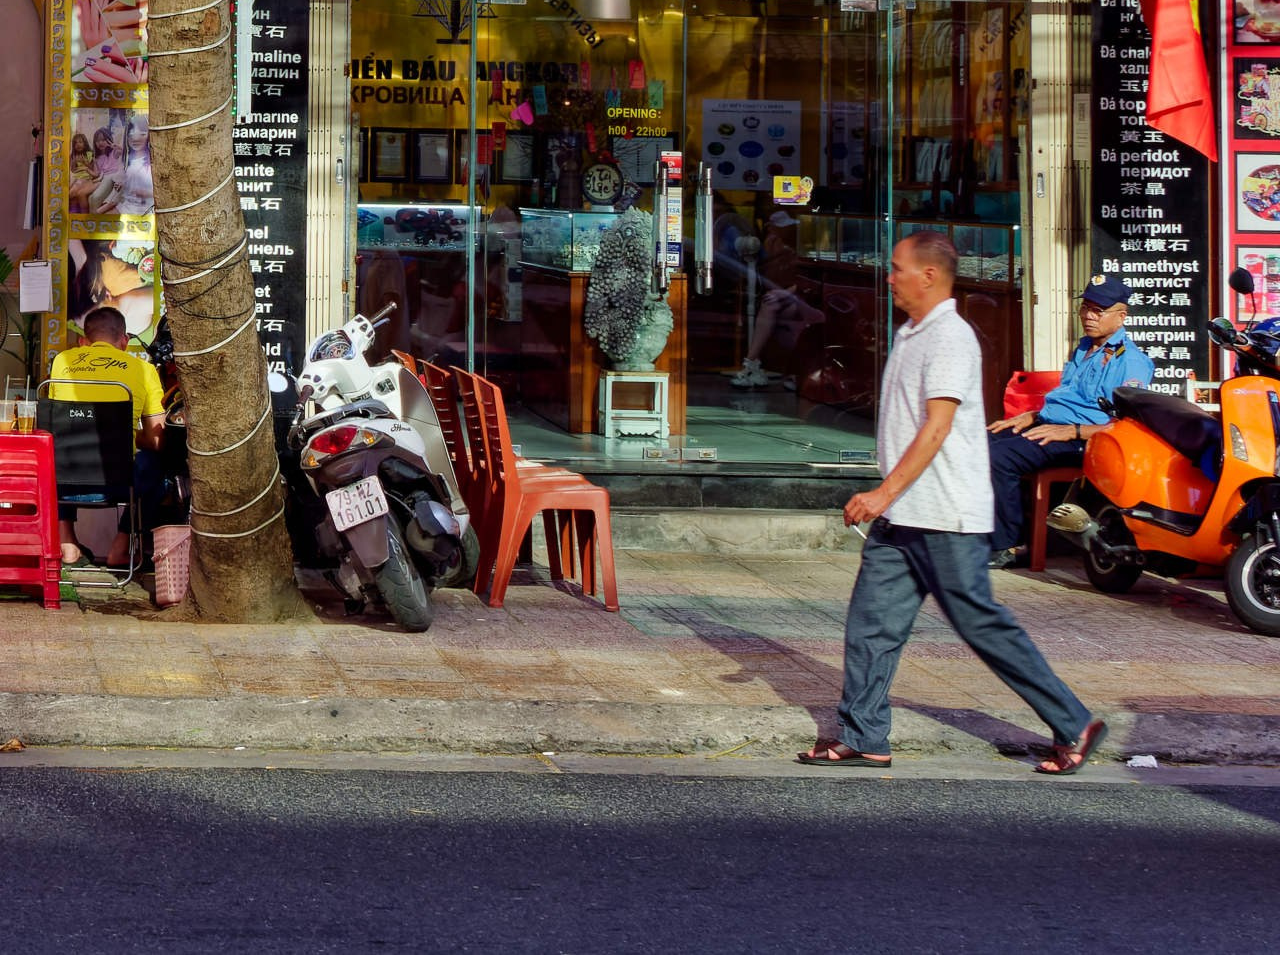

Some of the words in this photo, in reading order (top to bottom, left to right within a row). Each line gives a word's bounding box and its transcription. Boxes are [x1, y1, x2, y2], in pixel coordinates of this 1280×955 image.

[1101, 45, 1117, 59] Đá
[351, 51, 393, 81] IỂN
[402, 54, 457, 82] BÁU
[1100, 97, 1117, 110] Đá
[607, 106, 663, 120] OPENING:
[636, 125, 668, 138] 22h00
[1101, 149, 1117, 162] Đá
[1120, 149, 1180, 165] peridot
[1120, 167, 1192, 180] перидот
[1120, 182, 1166, 196] 茶晶
[1101, 205, 1118, 219] Đá
[1120, 205, 1164, 220] citrin
[1121, 224, 1182, 237] цитрин
[1102, 258, 1120, 273] Đá
[1122, 259, 1200, 276] amethyst
[1123, 277, 1192, 288] аметист
[1123, 313, 1186, 326] ametrin
[1125, 331, 1196, 344] аметрин
[87, 409, 94, 419] 2
[337, 497, 384, 527] 161.01
